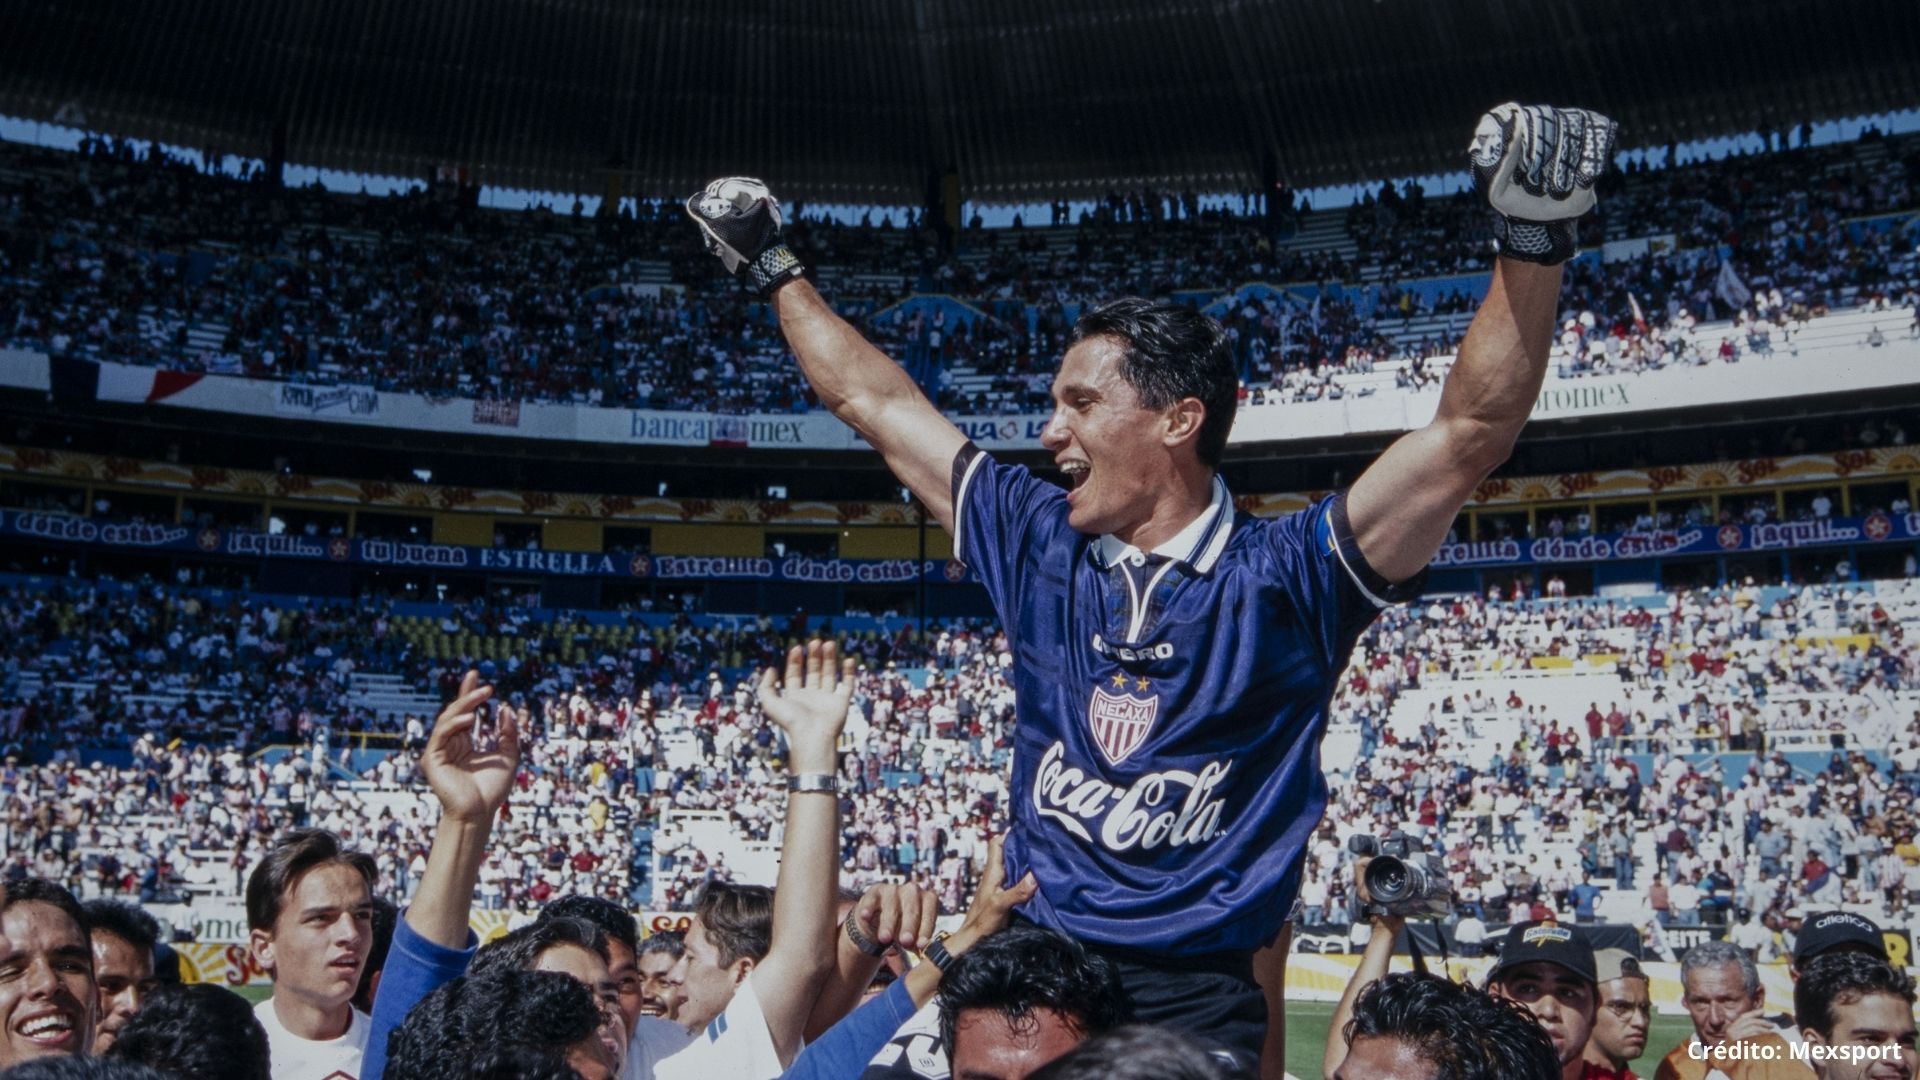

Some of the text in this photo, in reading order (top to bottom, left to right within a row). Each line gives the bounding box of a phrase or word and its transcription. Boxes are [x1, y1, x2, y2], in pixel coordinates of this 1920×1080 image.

[480, 548, 616, 574] ESTRELLA
[1431, 541, 1521, 565] rellita
[656, 555, 773, 578] Estrellita
[1097, 699, 1150, 722] NECAXA
[1033, 740, 1232, 851] Coca-Cola
